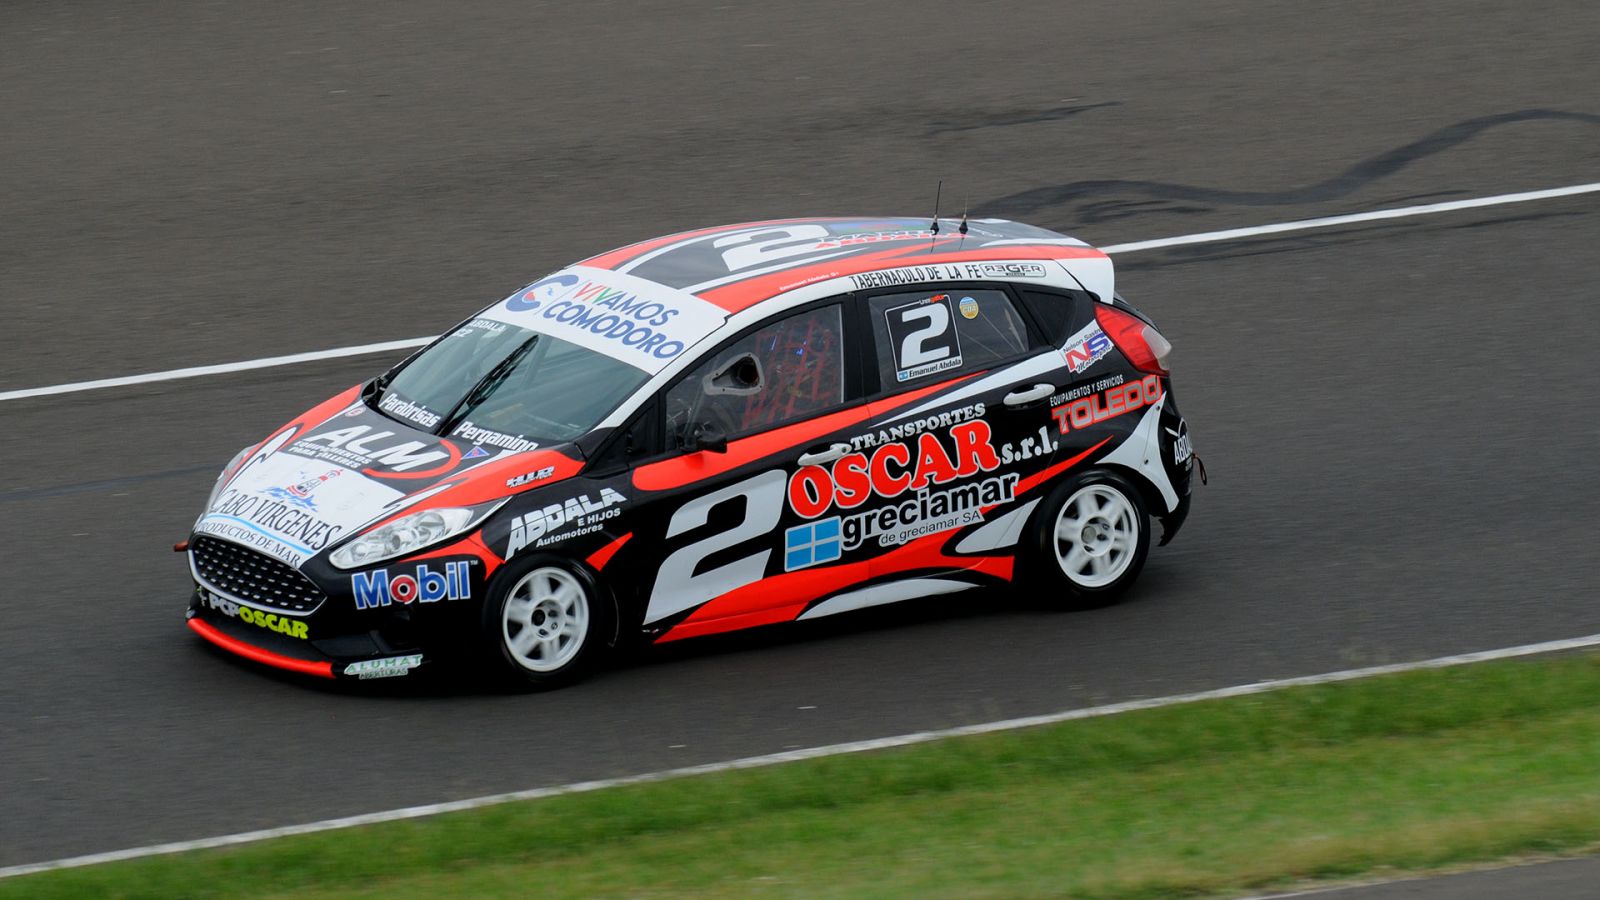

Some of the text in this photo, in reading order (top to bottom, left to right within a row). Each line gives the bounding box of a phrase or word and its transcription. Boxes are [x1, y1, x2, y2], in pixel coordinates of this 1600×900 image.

[713, 225, 840, 272] 2
[849, 267, 925, 290] TABERNACULO
[925, 266, 943, 280] DE
[945, 266, 962, 279] LA
[969, 265, 982, 279] FE
[576, 281, 680, 327] VIVAMOS
[542, 300, 685, 359] COMODORO
[901, 303, 950, 369] 2
[1063, 339, 1083, 353] Nelson
[909, 358, 962, 378] Emanuel Abdala
[1065, 332, 1109, 370] NS
[1050, 374, 1124, 407] EQUIPAMIENTOS Y SERVICIOS
[1052, 375, 1163, 435] TOLEDO
[378, 393, 441, 428] Parabrisas
[849, 403, 986, 451] TRANSPORTES
[302, 425, 450, 472] ALM
[787, 419, 1059, 519] OSCAR s.r.l.
[211, 488, 259, 518] CABO
[578, 507, 621, 527] E HIJOS
[843, 475, 1018, 548] greciamar
[505, 487, 628, 561] ABDALA
[536, 523, 604, 548] Automotores
[880, 509, 982, 545] de greciamar SA
[255, 536, 273, 548] DE
[272, 543, 301, 568] MAR
[642, 469, 788, 626] 2
[352, 561, 471, 611] Mobil
[239, 606, 309, 639] OSCAR
[345, 655, 422, 673] ALUMAT
